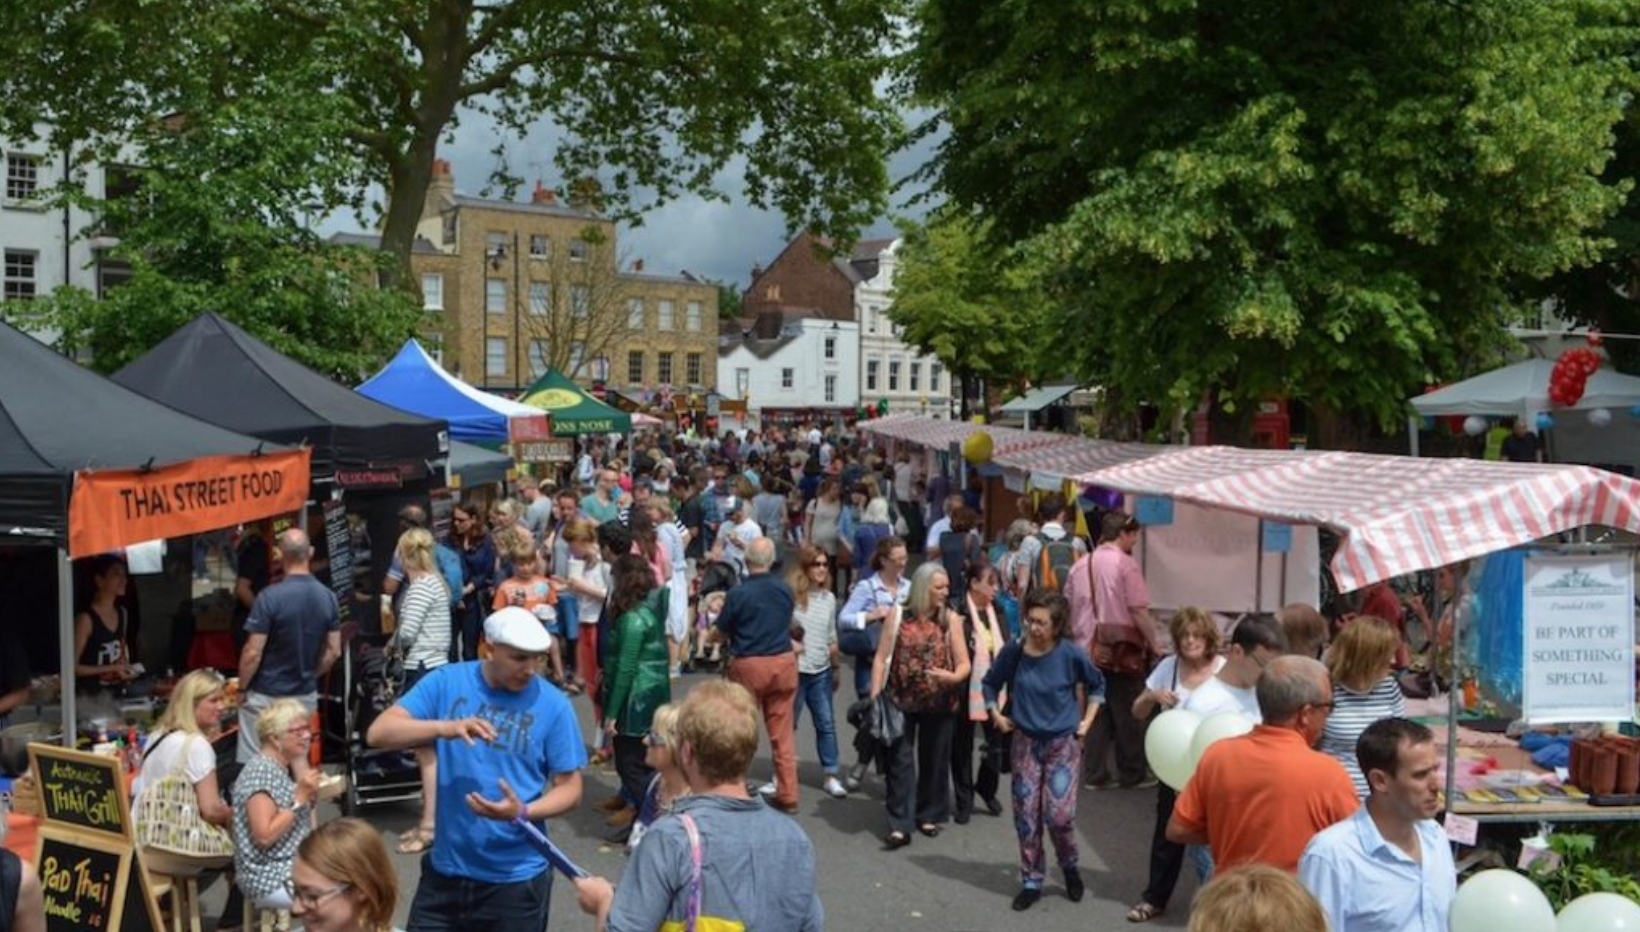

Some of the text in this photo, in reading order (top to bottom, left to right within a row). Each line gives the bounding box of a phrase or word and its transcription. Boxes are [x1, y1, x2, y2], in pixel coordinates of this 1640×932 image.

[579, 419, 614, 431] NOSE
[120, 469, 282, 520] THAI STREET FOOD
[1535, 626, 1619, 639] BE PART OF
[1532, 650, 1623, 662] SOMETHING
[1546, 672, 1607, 685] SPECIAL
[44, 896, 81, 923] Noodle
